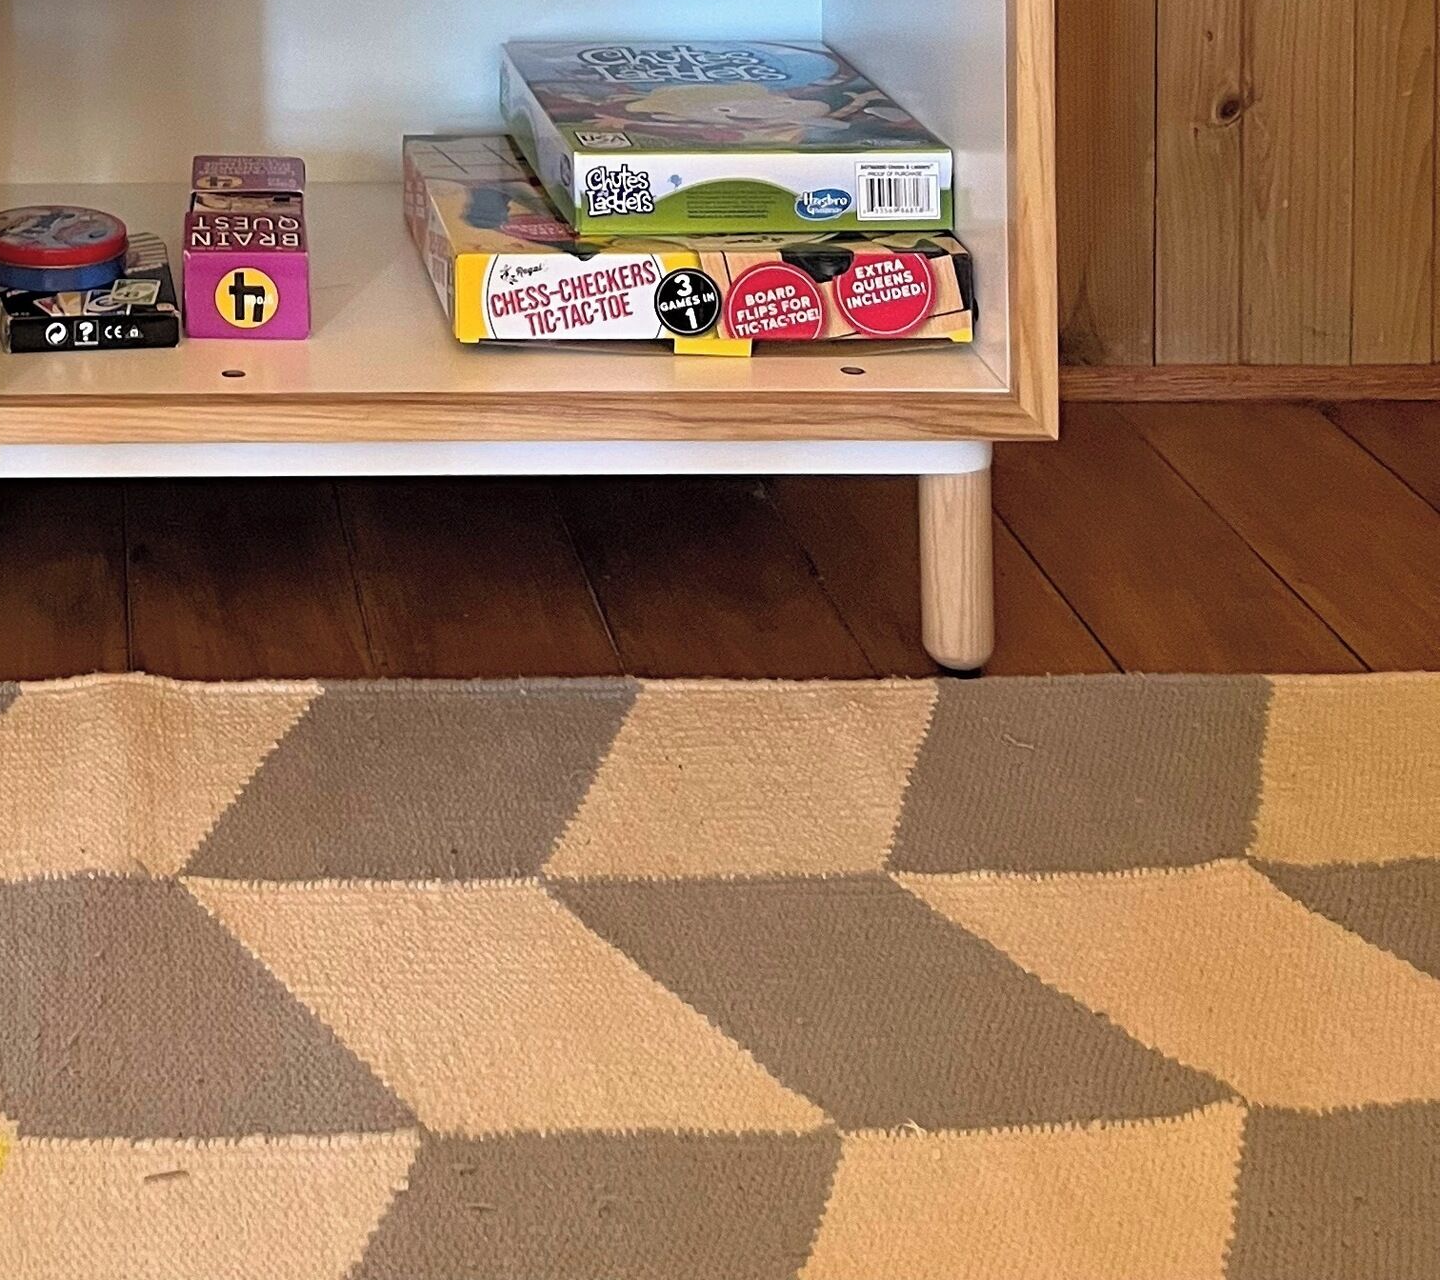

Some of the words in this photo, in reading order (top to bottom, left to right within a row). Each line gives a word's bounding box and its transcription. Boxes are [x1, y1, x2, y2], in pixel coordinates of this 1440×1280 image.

[586, 164, 650, 191] Chutes
[587, 189, 655, 217] Ladders
[191, 216, 300, 231] QUEST
[190, 231, 300, 247] BRAIN
[855, 258, 905, 280] EXTRA
[490, 260, 657, 319] CHESS-CHECKERS
[673, 274, 693, 297] 3
[852, 271, 914, 295] QUEENS
[659, 297, 701, 313] GAMES
[703, 291, 715, 304] IN
[744, 285, 797, 307] BOARD
[846, 282, 927, 310] INCLUDED!
[524, 292, 634, 337] TIC-TAC-TOE
[684, 307, 698, 330] 1
[736, 303, 778, 323] FLIPS
[781, 296, 812, 313] FOR
